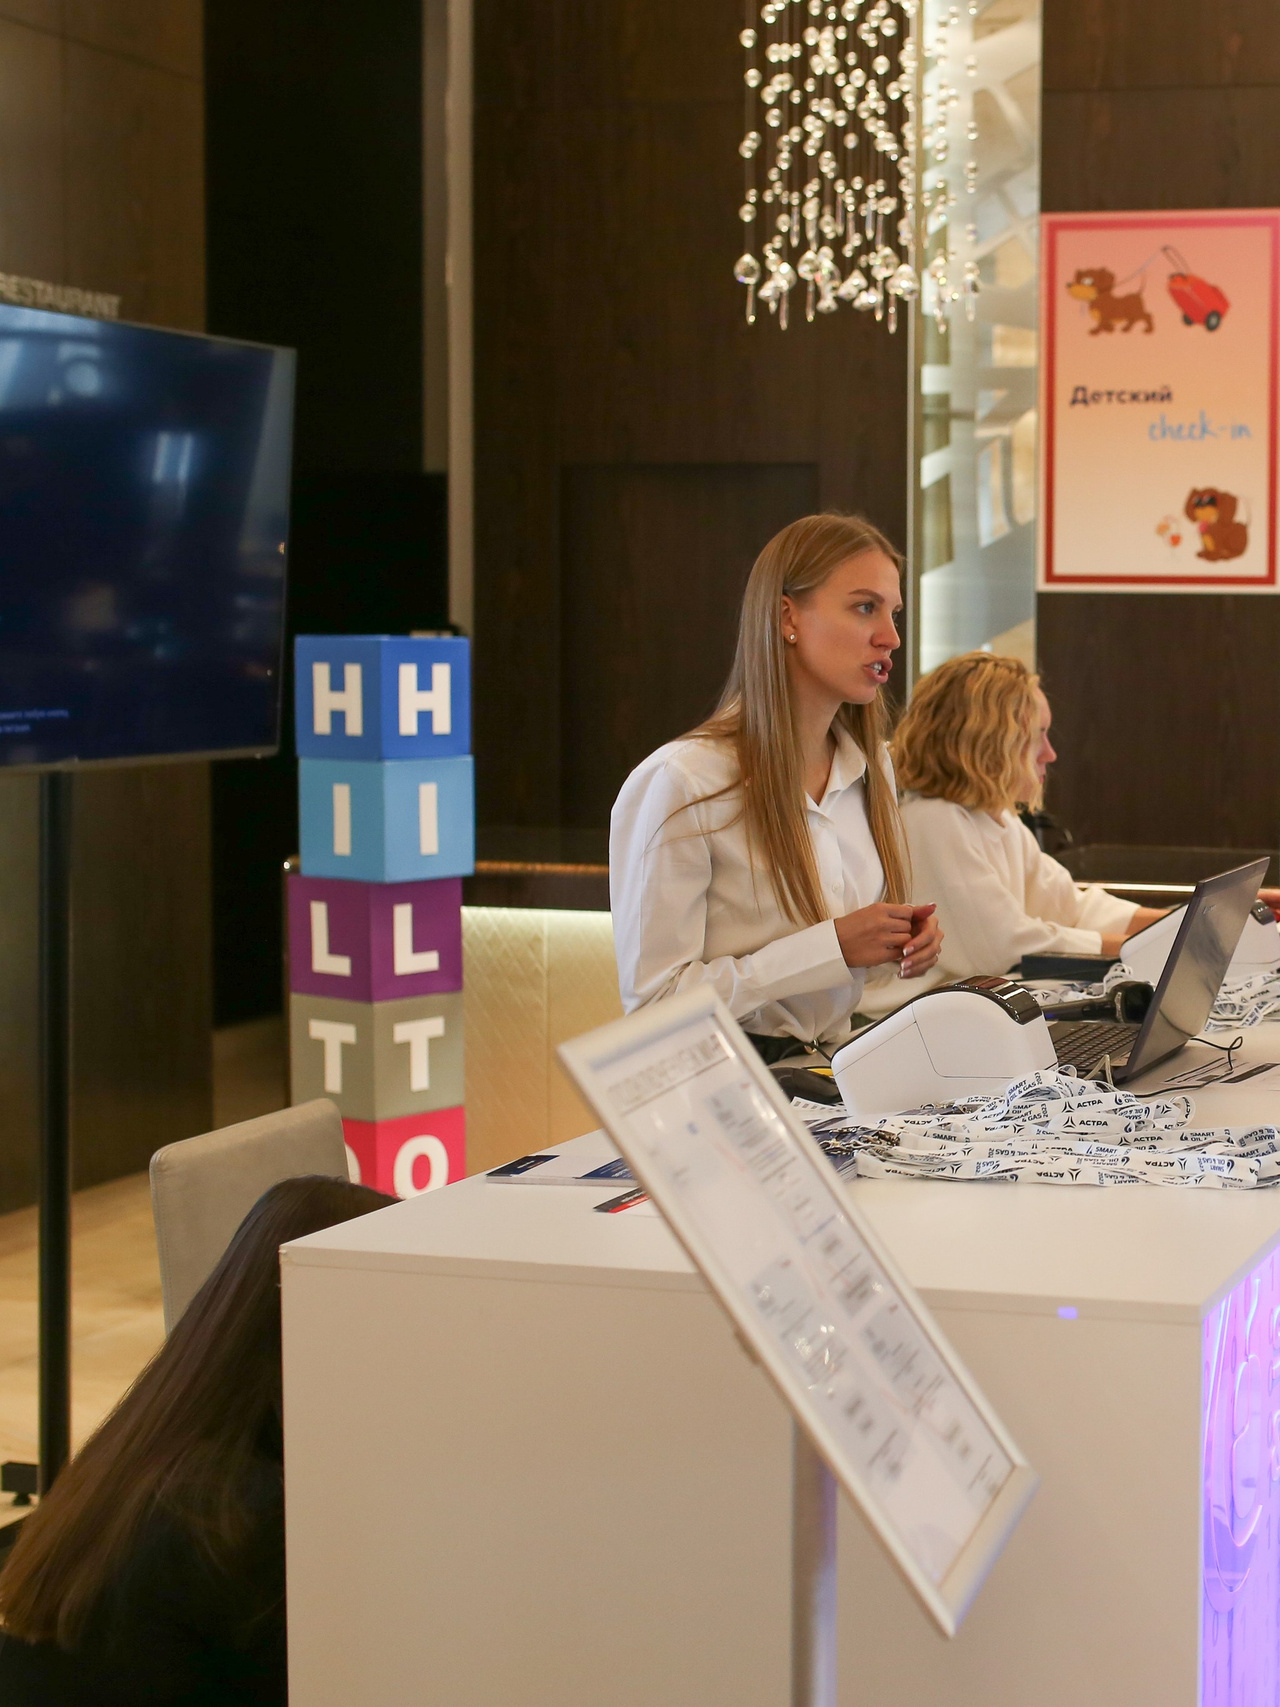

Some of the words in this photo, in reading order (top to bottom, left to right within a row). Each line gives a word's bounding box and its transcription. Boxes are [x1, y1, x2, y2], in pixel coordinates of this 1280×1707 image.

[1070, 384, 1173, 406] Детский
[1149, 411, 1252, 441] check-in
[1008, 1080, 1027, 1096] SMART
[1009, 1093, 1017, 1102] OIL
[1022, 1081, 1037, 1092] GAS
[1078, 1085, 1086, 1096] 023
[1076, 1099, 1103, 1108] АСТРА
[1027, 1112, 1042, 1120] GAS
[1079, 1119, 1108, 1127] АСТРА
[932, 1133, 957, 1141] SMART
[1244, 1130, 1258, 1139] GAS
[1095, 1146, 1118, 1154] SMART
